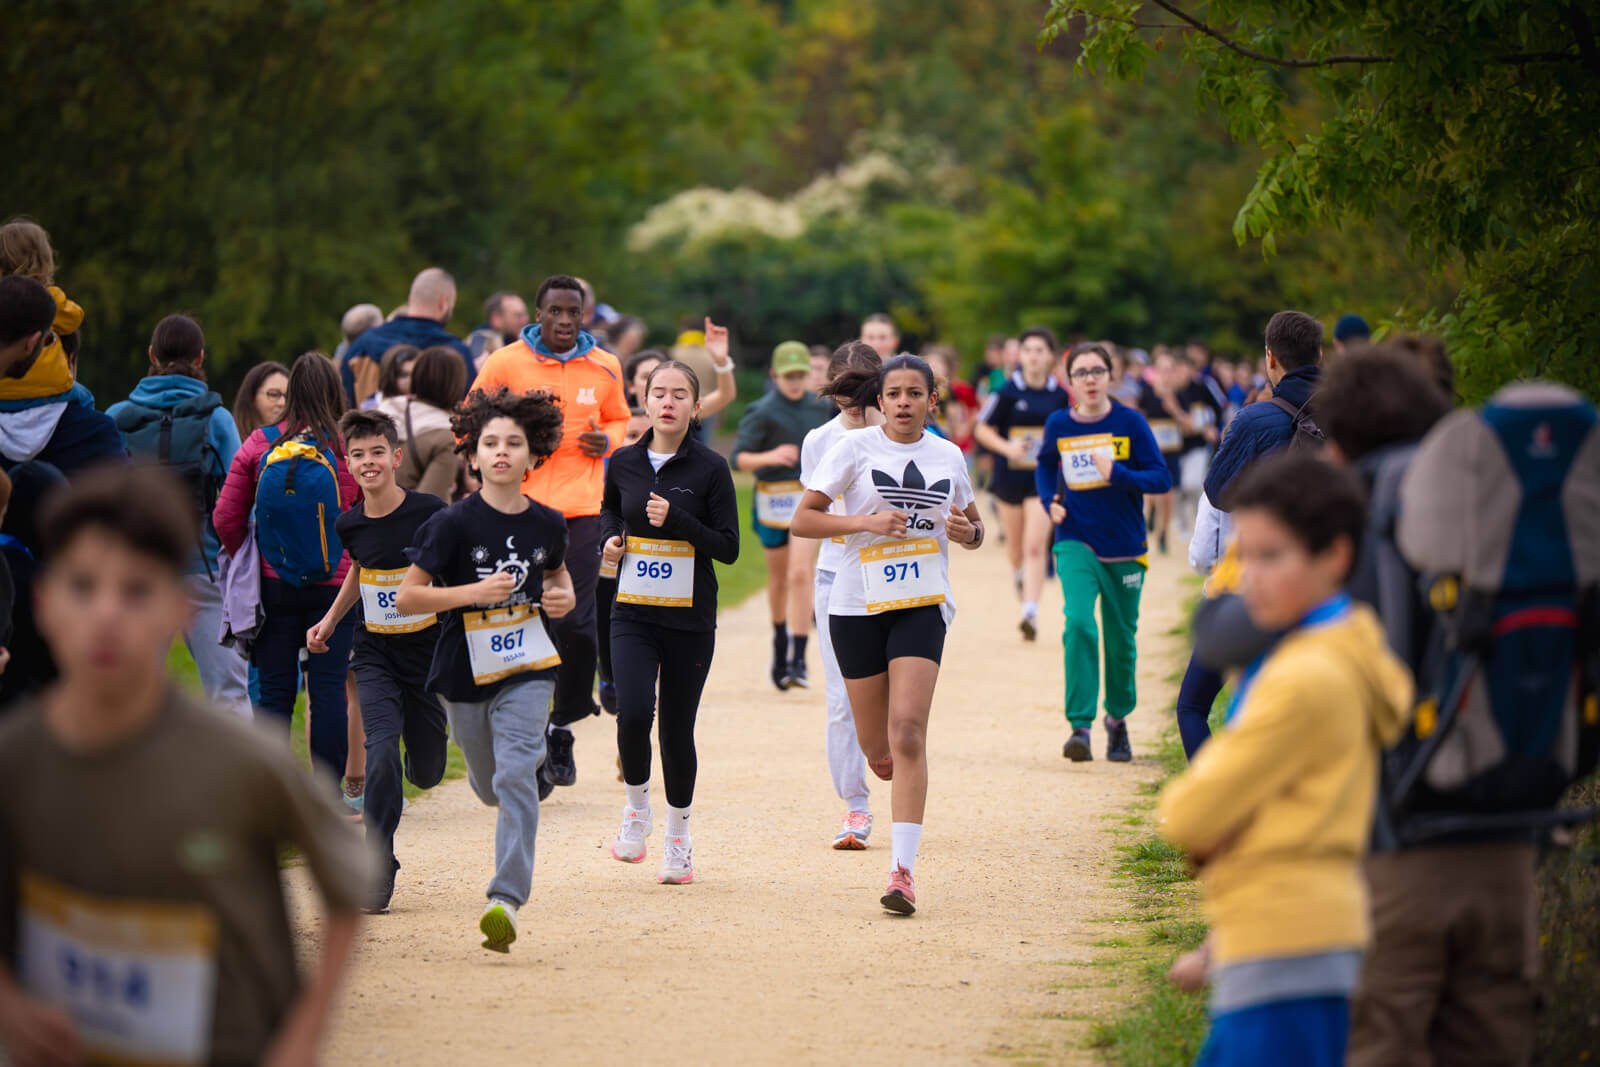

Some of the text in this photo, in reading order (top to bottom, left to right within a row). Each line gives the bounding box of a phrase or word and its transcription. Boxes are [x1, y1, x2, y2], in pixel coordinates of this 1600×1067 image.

[906, 513, 934, 530] das
[637, 560, 673, 579] 969
[883, 561, 920, 583] 971
[377, 591, 397, 608] 89
[490, 628, 524, 653] 867
